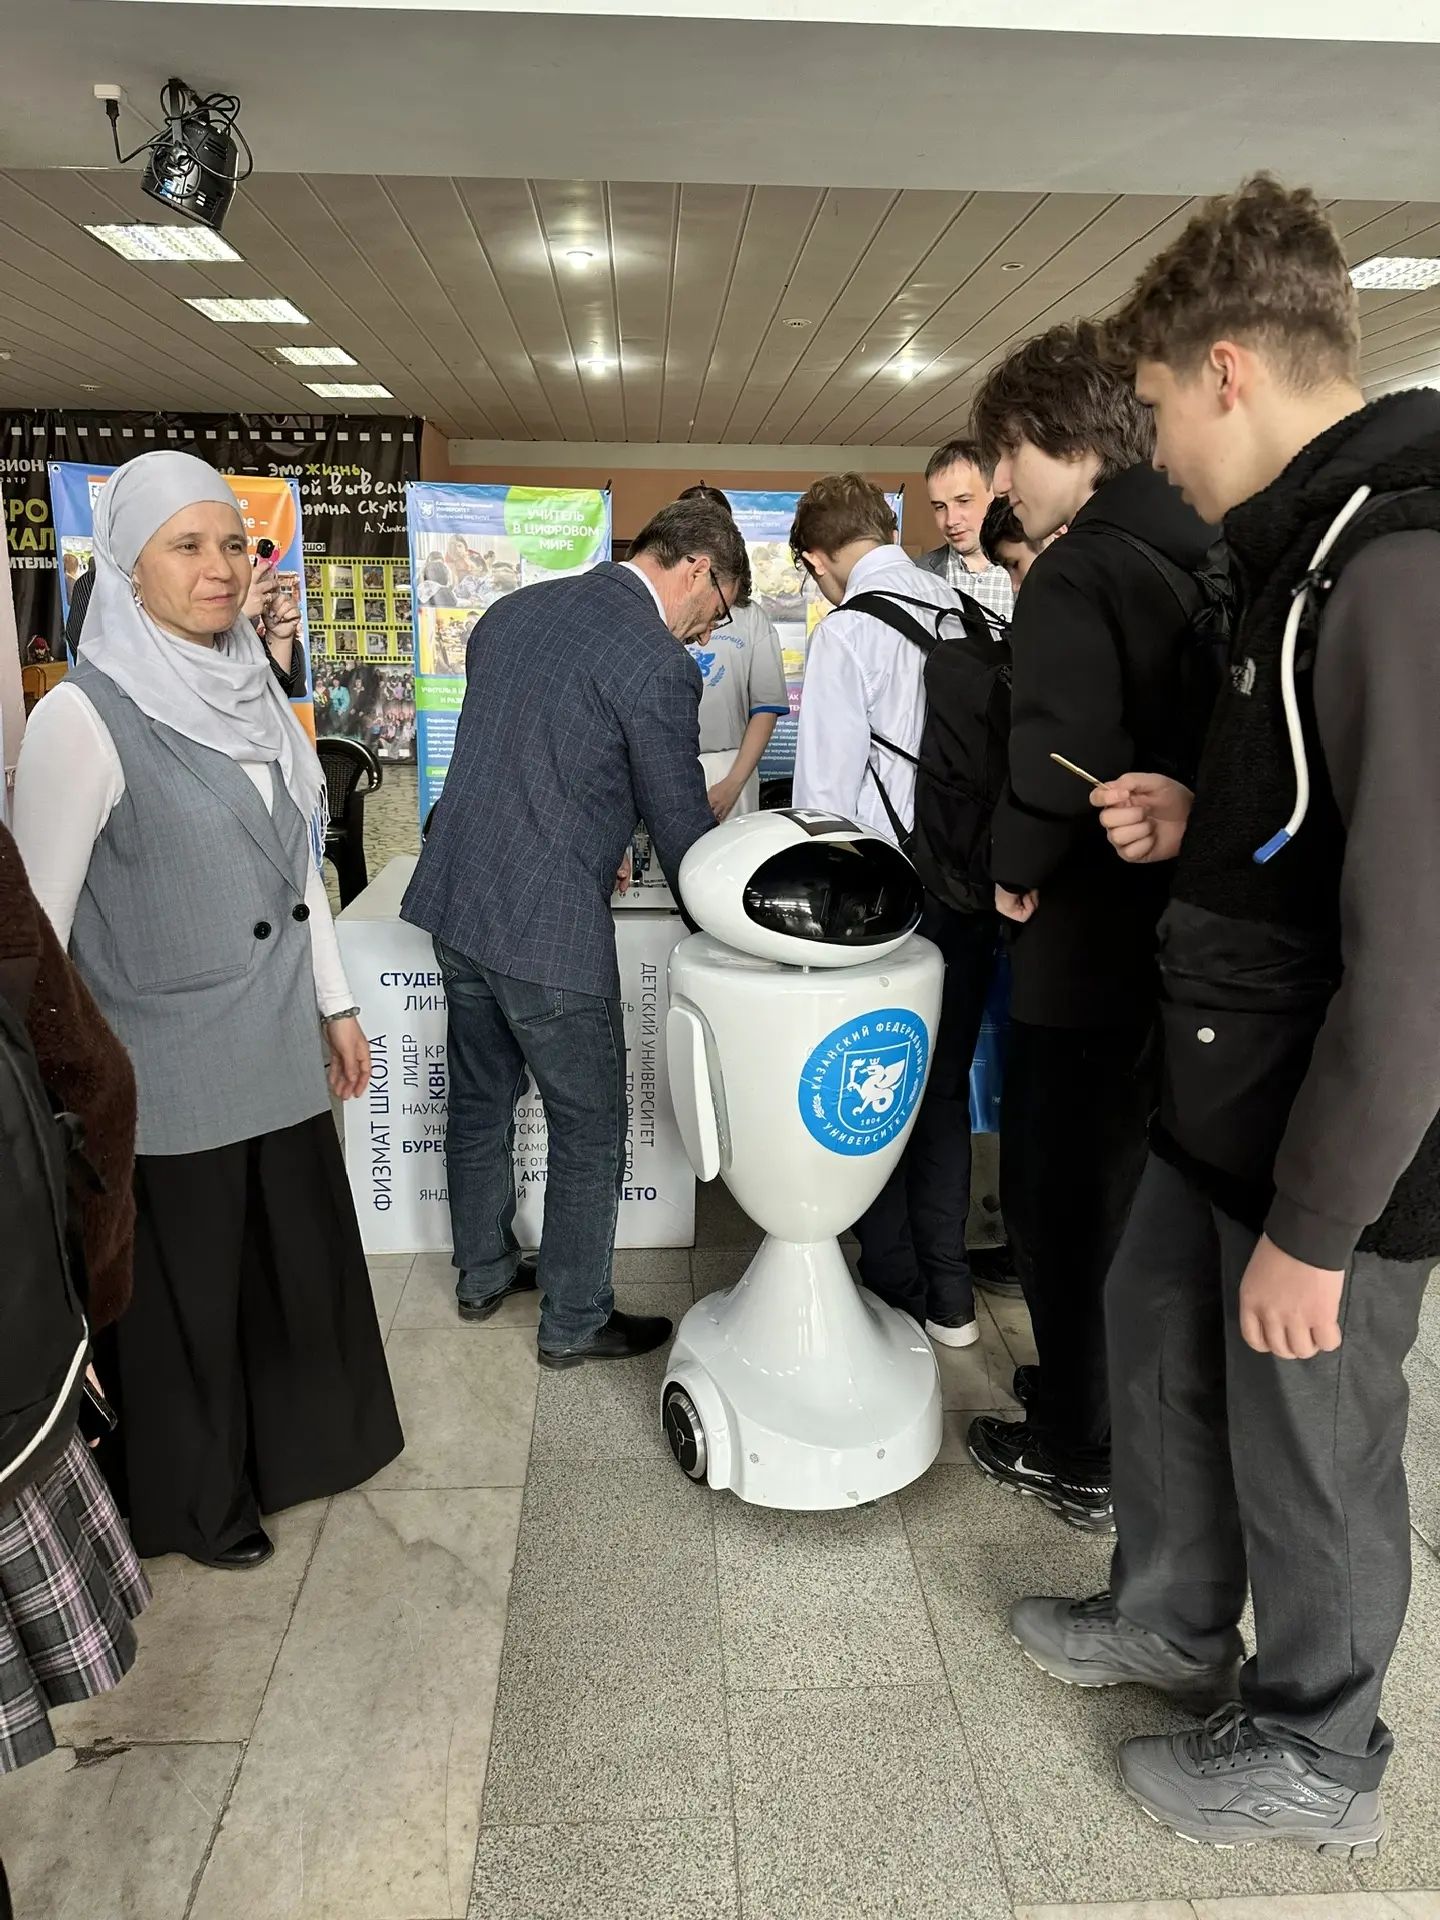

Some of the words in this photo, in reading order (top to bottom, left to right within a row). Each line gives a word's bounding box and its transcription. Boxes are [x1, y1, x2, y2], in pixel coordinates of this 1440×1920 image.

[302, 502, 351, 516] ятна
[527, 508, 585, 521] УЧИТЕЛЬ
[377, 522, 409, 534] Хичко
[513, 521, 521, 534] В
[524, 524, 600, 537] ЦИФРОВОМ
[539, 539, 574, 551] МИРЕ
[403, 995, 447, 1011] ЛИН
[640, 962, 659, 1035] ДЕТСКИЙ
[402, 1034, 419, 1088] ЛИДЕР
[811, 1025, 870, 1090] КАЗАНСКИЙ
[875, 1021, 924, 1074] ФЕДЕРАЛЬНЫЙ
[367, 1034, 390, 1114] ШКОЛА
[428, 1062, 446, 1100] КВН
[640, 1039, 656, 1148] УНИВЕРСИТЕТ
[513, 1107, 546, 1119] ОЛО
[860, 1116, 881, 1126] 1804
[822, 1109, 907, 1146] УНИВЕРСИТЕТ
[402, 1140, 446, 1153] БУРЕ
[370, 1121, 393, 1211] ФИЗМАТ
